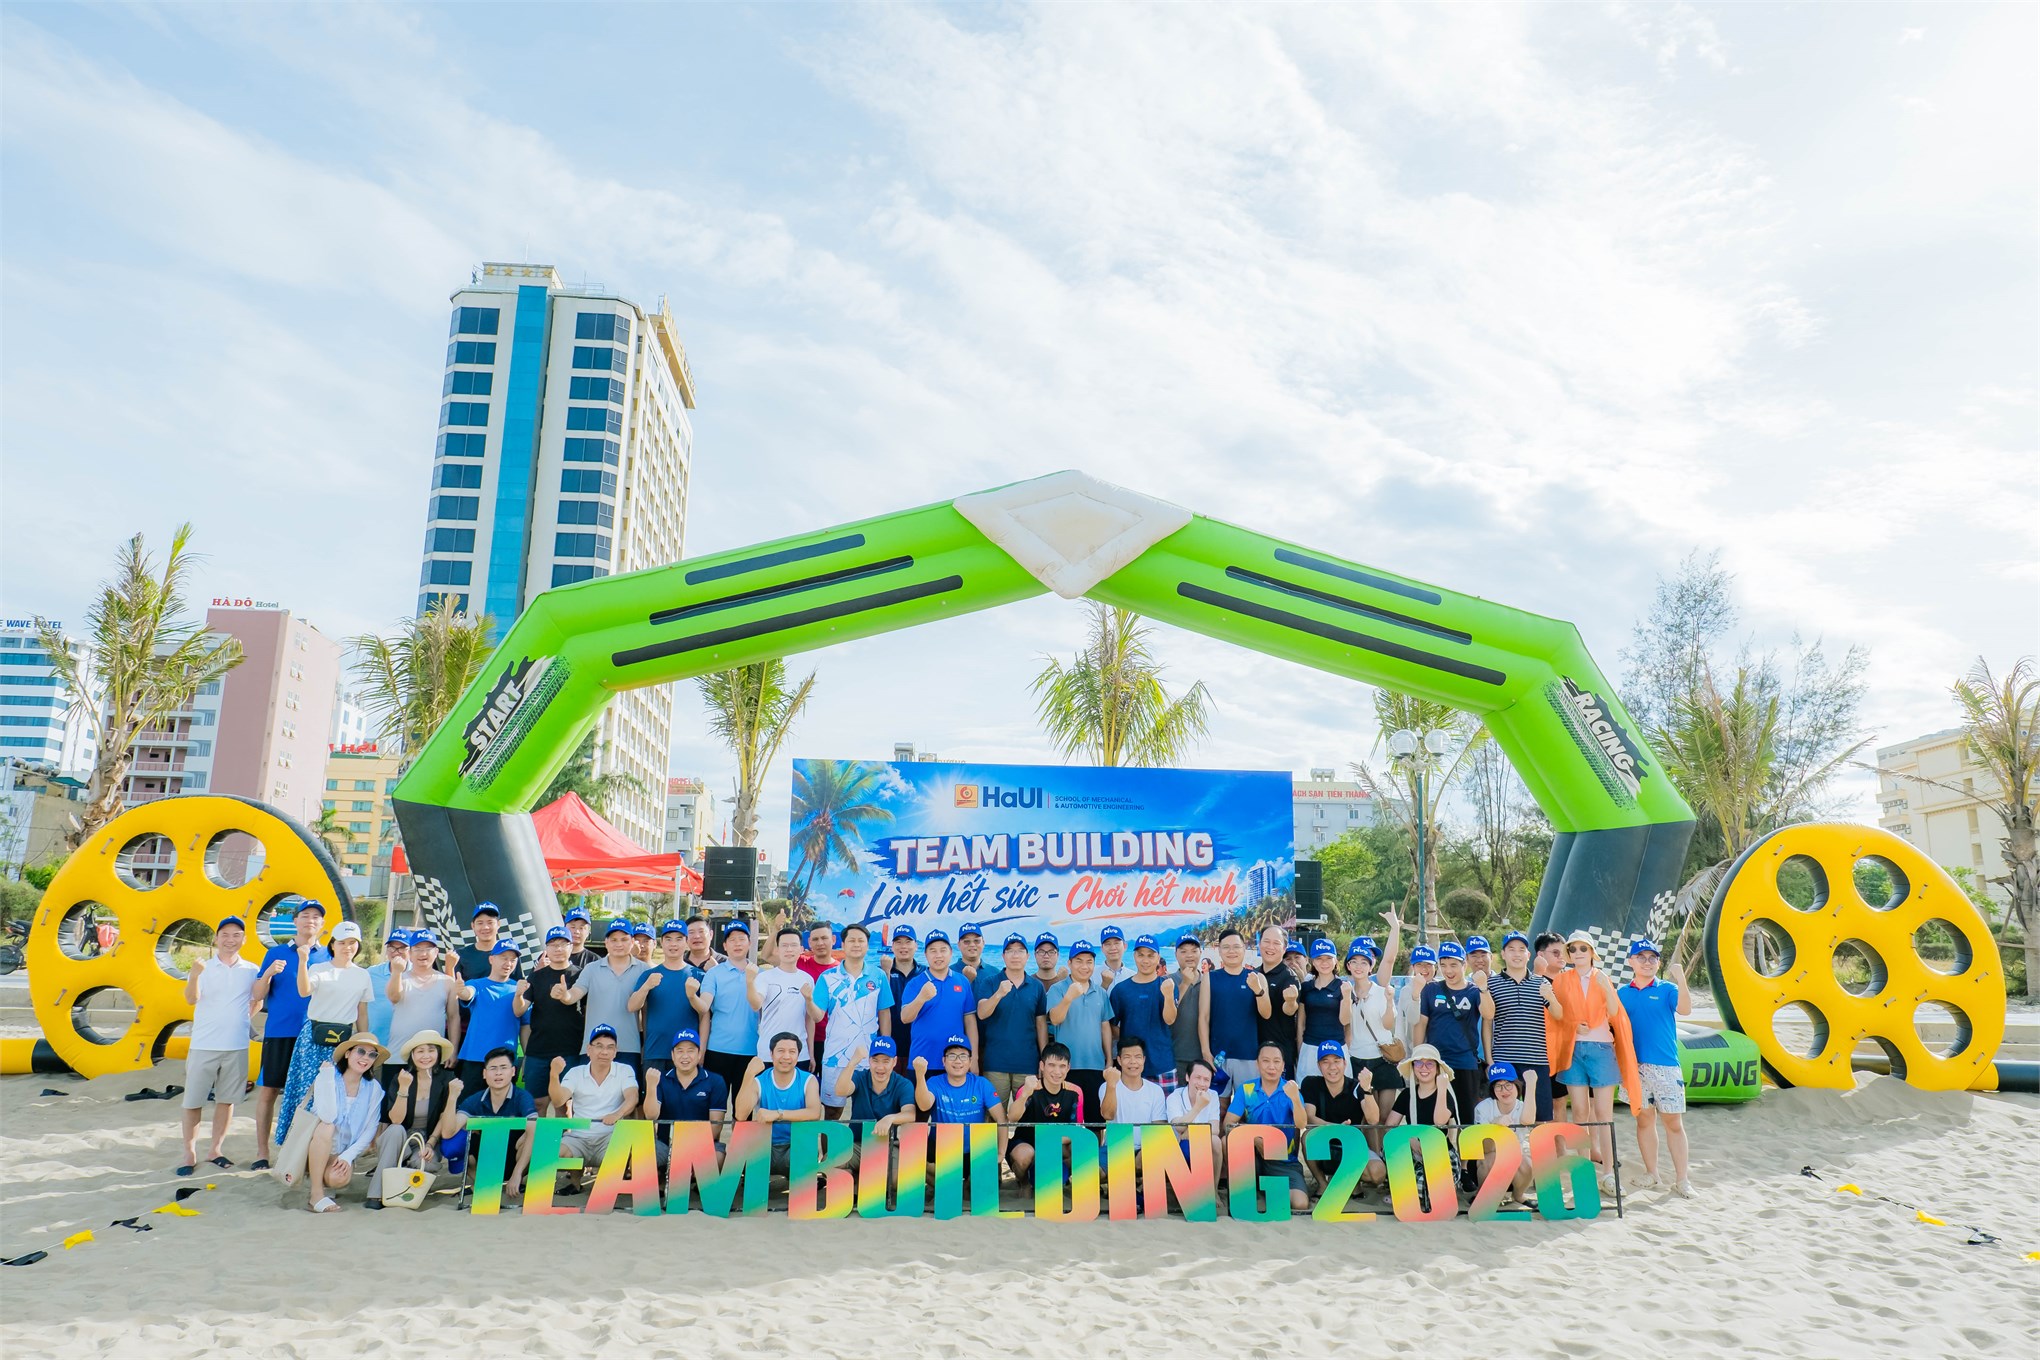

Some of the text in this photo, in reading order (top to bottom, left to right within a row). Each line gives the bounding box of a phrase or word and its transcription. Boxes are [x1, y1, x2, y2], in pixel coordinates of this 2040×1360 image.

[6, 620, 31, 628] WAVE
[470, 679, 523, 751] START
[1573, 692, 1635, 771] RACING
[890, 831, 1214, 875] TEAM BUILDING
[858, 881, 930, 926] Làm
[936, 874, 990, 915] hết
[991, 880, 1042, 914] sức
[1066, 875, 1129, 916] Chơi
[1133, 872, 1180, 908] hết
[1181, 871, 1239, 906] mình
[1684, 1060, 1758, 1088] DING
[466, 1117, 1602, 1222] TEAM BUILDING 2026
